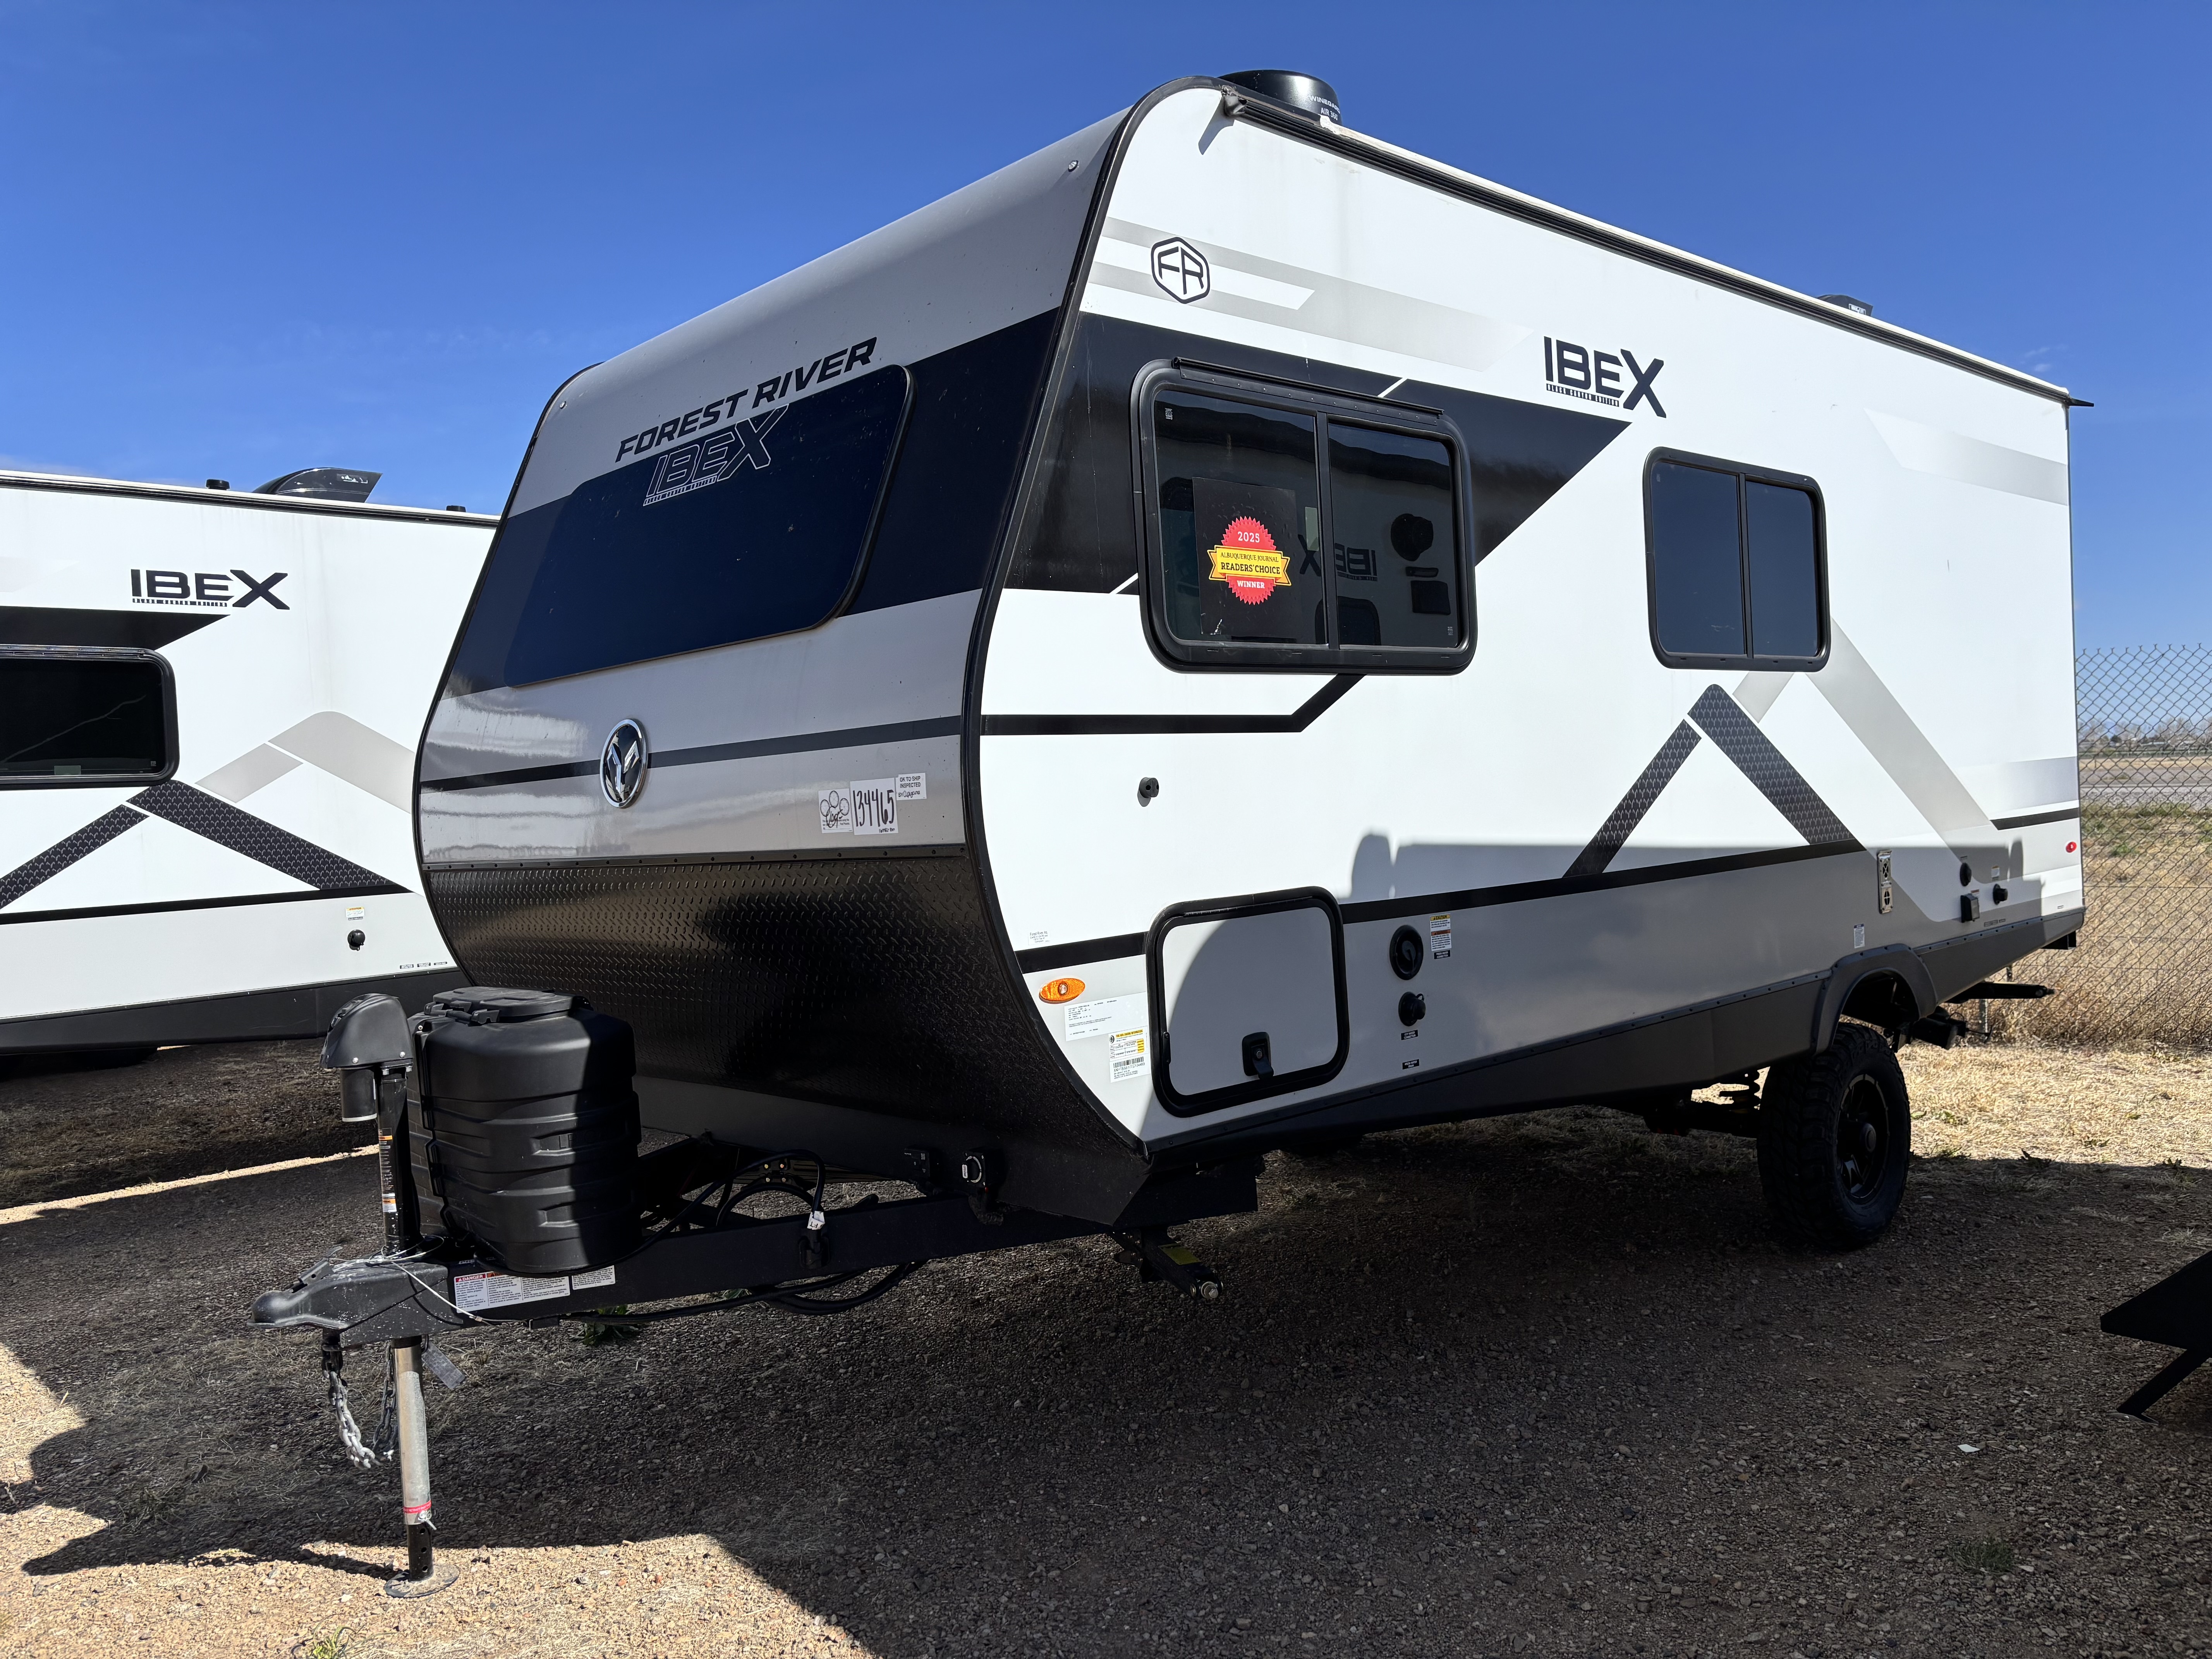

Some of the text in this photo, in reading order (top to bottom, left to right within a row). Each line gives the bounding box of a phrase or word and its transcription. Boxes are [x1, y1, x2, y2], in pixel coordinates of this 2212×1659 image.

[1321, 107, 1329, 116] AIR
[1544, 336, 1666, 418] IBEX
[615, 337, 877, 463] FOREST RIVER
[646, 404, 789, 497] IBEX
[1238, 531, 1260, 543] 2025
[1221, 562, 1280, 574] READERS' CHOICE
[1237, 580, 1265, 589] WINNER
[131, 569, 290, 610] IBEX
[853, 788, 894, 827] 134465
